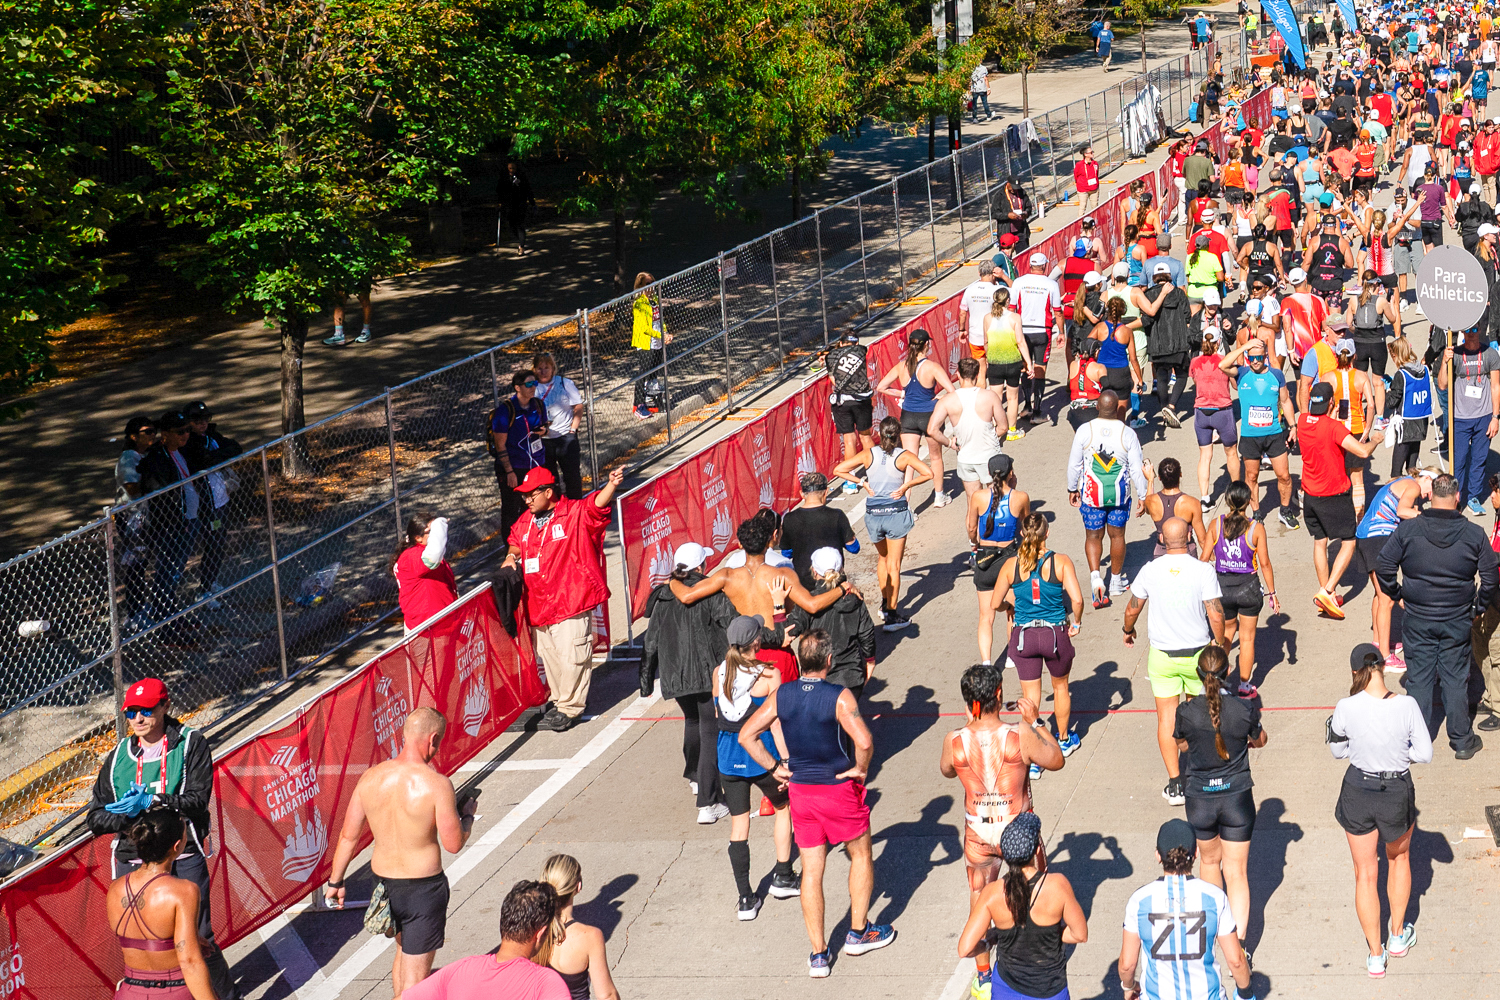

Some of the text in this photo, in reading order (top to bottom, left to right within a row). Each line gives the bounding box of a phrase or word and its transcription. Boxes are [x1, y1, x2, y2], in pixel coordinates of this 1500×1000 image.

[1434, 267, 1466, 283] Para
[1419, 283, 1485, 303] Athletics
[1413, 390, 1428, 405] NP
[703, 480, 725, 501] CHICAGO
[705, 491, 728, 510] MARATHON
[641, 514, 671, 539] CHICAGO
[642, 525, 673, 549] MARATHON
[457, 640, 485, 672] CHICAGO
[459, 654, 486, 684] MARATHON
[373, 698, 407, 733] CHICAGO
[263, 757, 313, 792] BANK OF AMERICA
[266, 767, 316, 809] CHICAGO
[270, 782, 320, 823] MARATHON
[1148, 910, 1207, 961] 23
